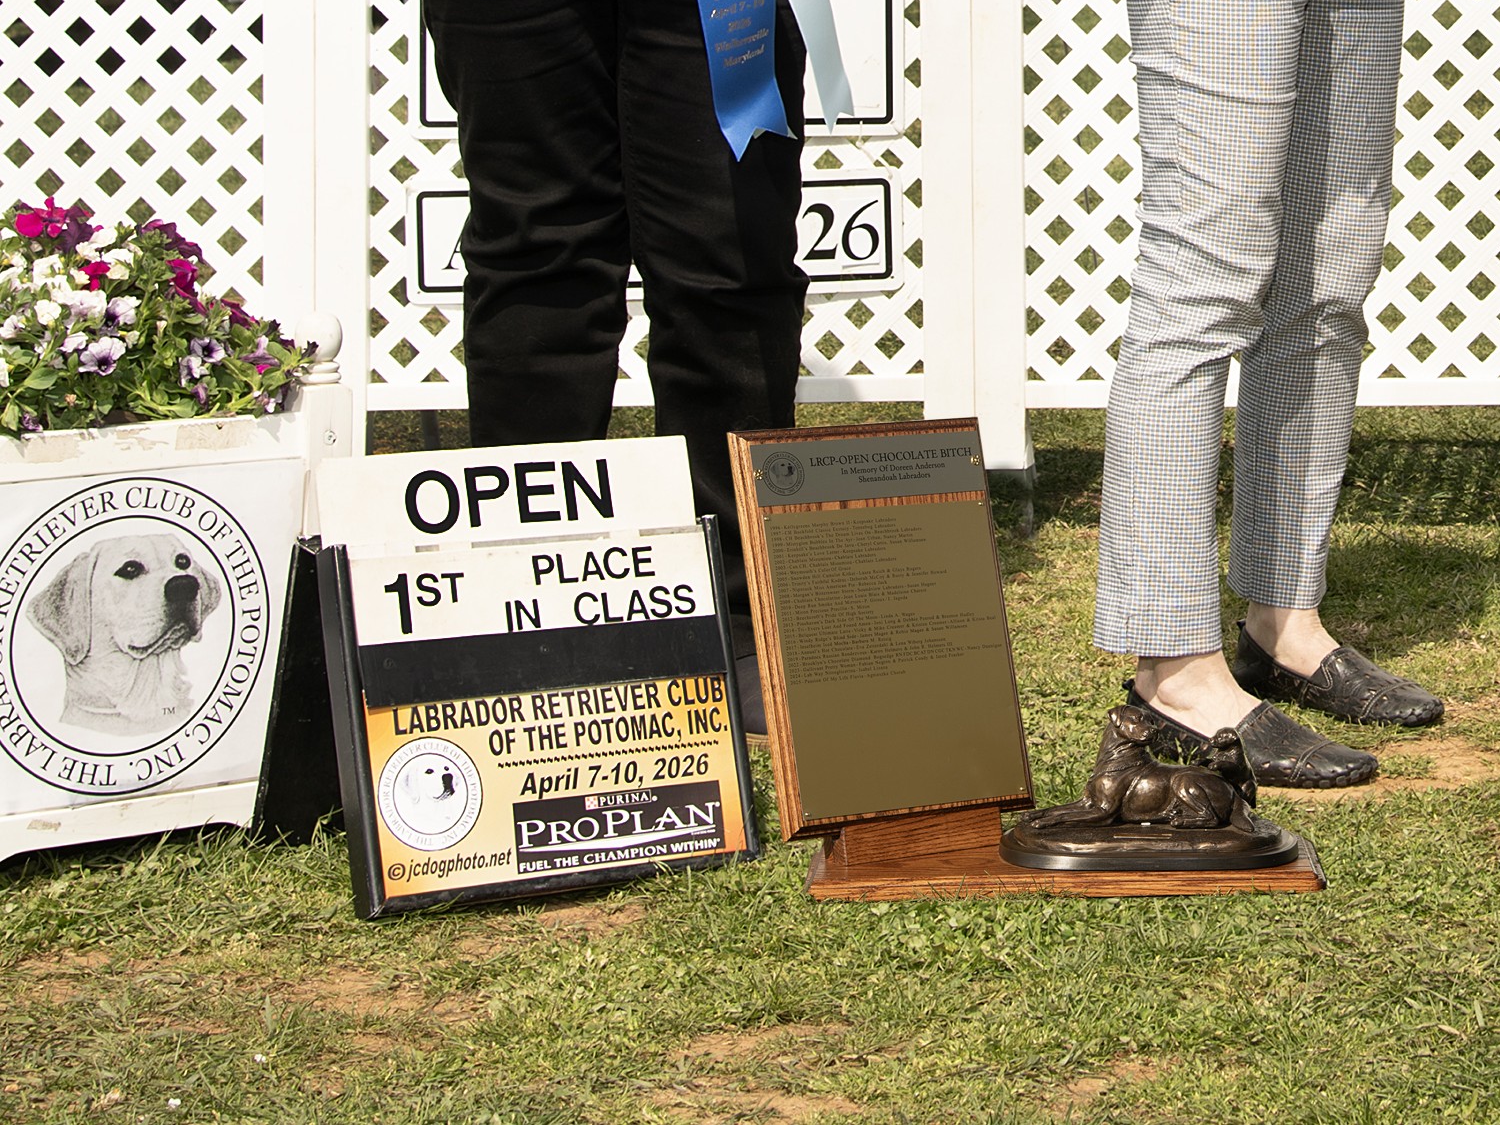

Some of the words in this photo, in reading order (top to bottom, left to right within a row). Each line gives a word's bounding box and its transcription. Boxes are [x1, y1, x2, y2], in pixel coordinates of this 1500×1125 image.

[723, 44, 765, 68] Maryland
[809, 454, 870, 467] LRCP-OPEN
[871, 449, 939, 463] CHOCOLATE
[940, 447, 973, 458] BITCH
[850, 465, 878, 475] Memory
[879, 464, 889, 473] Of
[890, 463, 914, 472] Doreen
[915, 461, 946, 471] Anderson
[858, 474, 898, 483] Shenandoah
[899, 472, 931, 481] Labradors
[125, 486, 197, 519] CLUB
[404, 458, 615, 535] OPEN
[198, 509, 234, 543] OF
[225, 541, 261, 601] THE
[384, 572, 465, 635] 1ST
[532, 545, 656, 586] PLACE
[505, 599, 541, 633] IN
[574, 585, 697, 626] CLASS
[184, 606, 262, 747] POTOMAC,
[392, 695, 524, 736] LABRADOR
[534, 681, 661, 720] RETRIEVER
[667, 676, 725, 707] CLUB
[489, 729, 517, 756] OF
[524, 723, 568, 752] THE
[574, 713, 682, 744] POTOMAC,
[687, 706, 728, 734] INC.
[58, 756, 117, 787] THE
[129, 743, 187, 782] INC.
[520, 766, 579, 798] April
[588, 760, 645, 787] 7-10,
[653, 753, 710, 780] 2026
[599, 792, 650, 807] PURINA
[519, 860, 552, 873] FUEL
[554, 855, 580, 868] THE
[583, 845, 667, 864] CHAMPION
